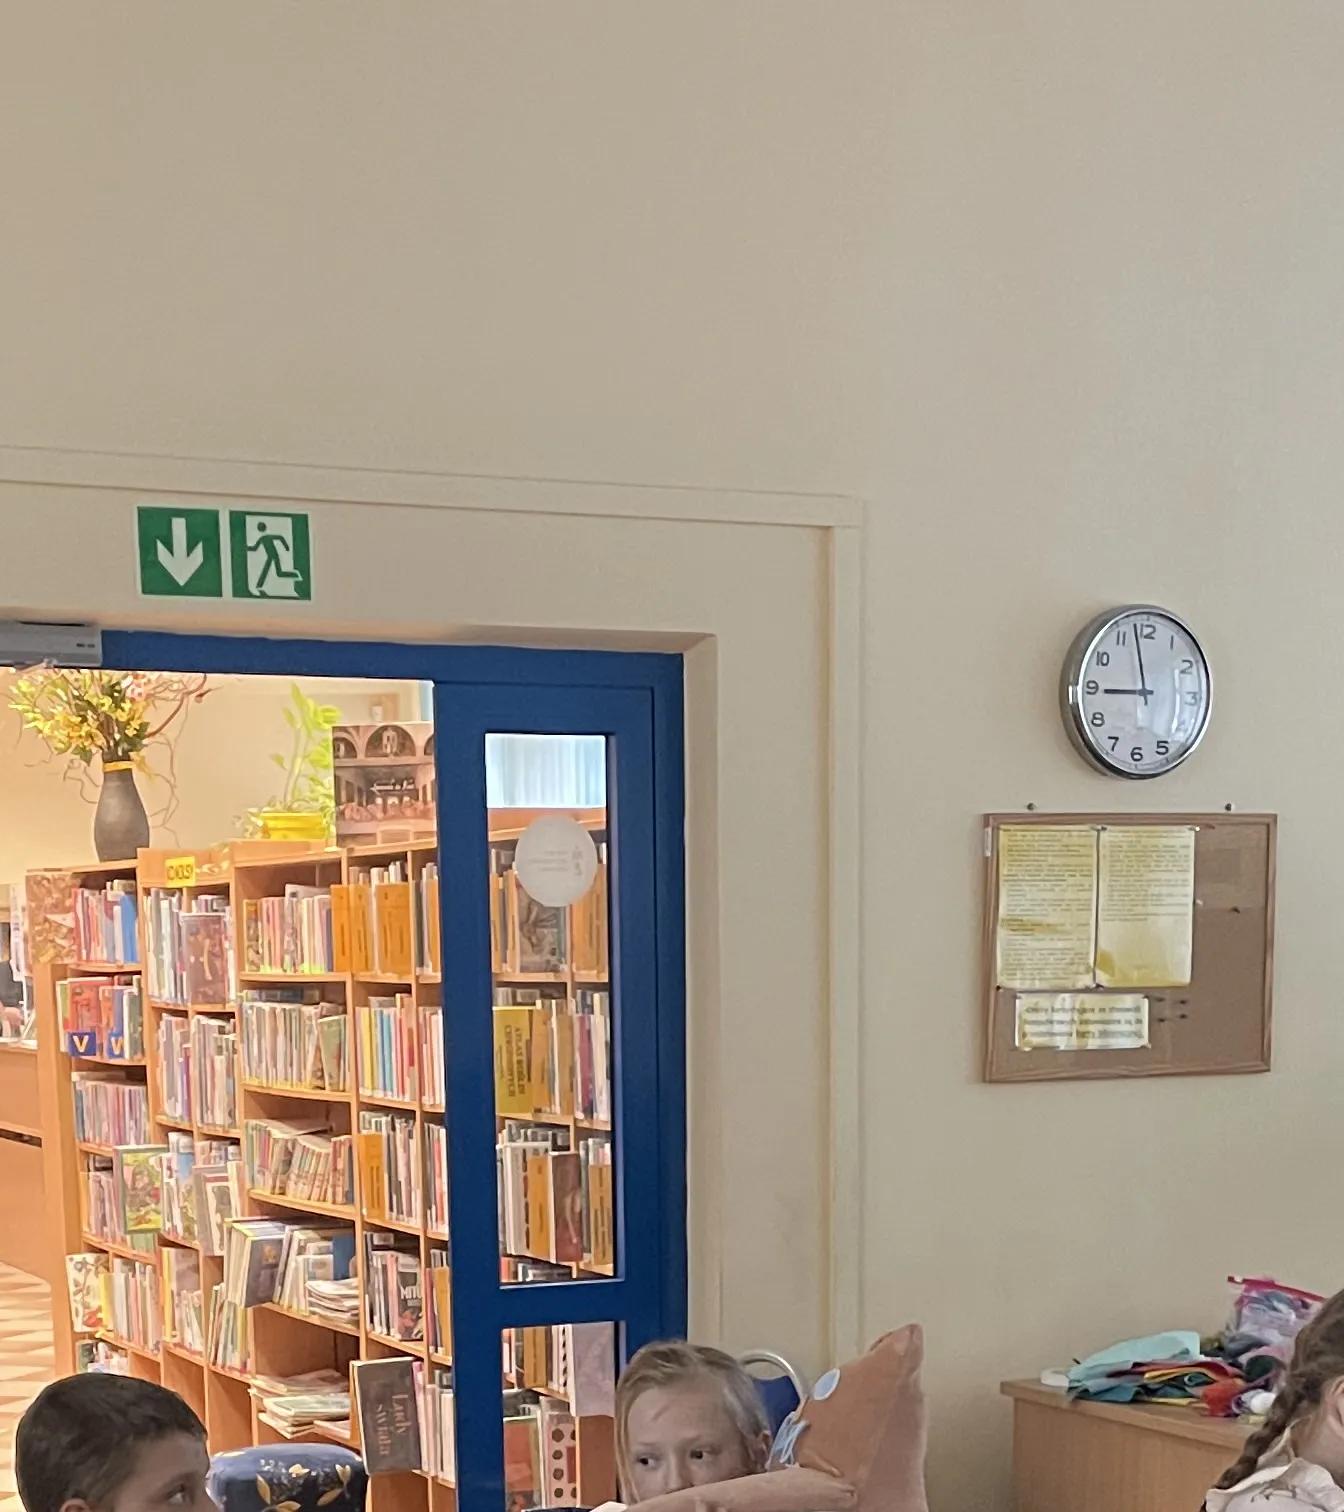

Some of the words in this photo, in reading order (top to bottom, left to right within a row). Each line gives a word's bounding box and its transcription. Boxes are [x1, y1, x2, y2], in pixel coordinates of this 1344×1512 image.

[1116, 630, 1127, 646] 11
[1096, 651, 1110, 666] 10
[1180, 659, 1194, 674] 2
[1086, 680, 1099, 695] 9
[1091, 712, 1105, 727] 8
[1108, 736, 1119, 752] 7
[1156, 741, 1169, 755] 5
[1130, 747, 1143, 762] 6
